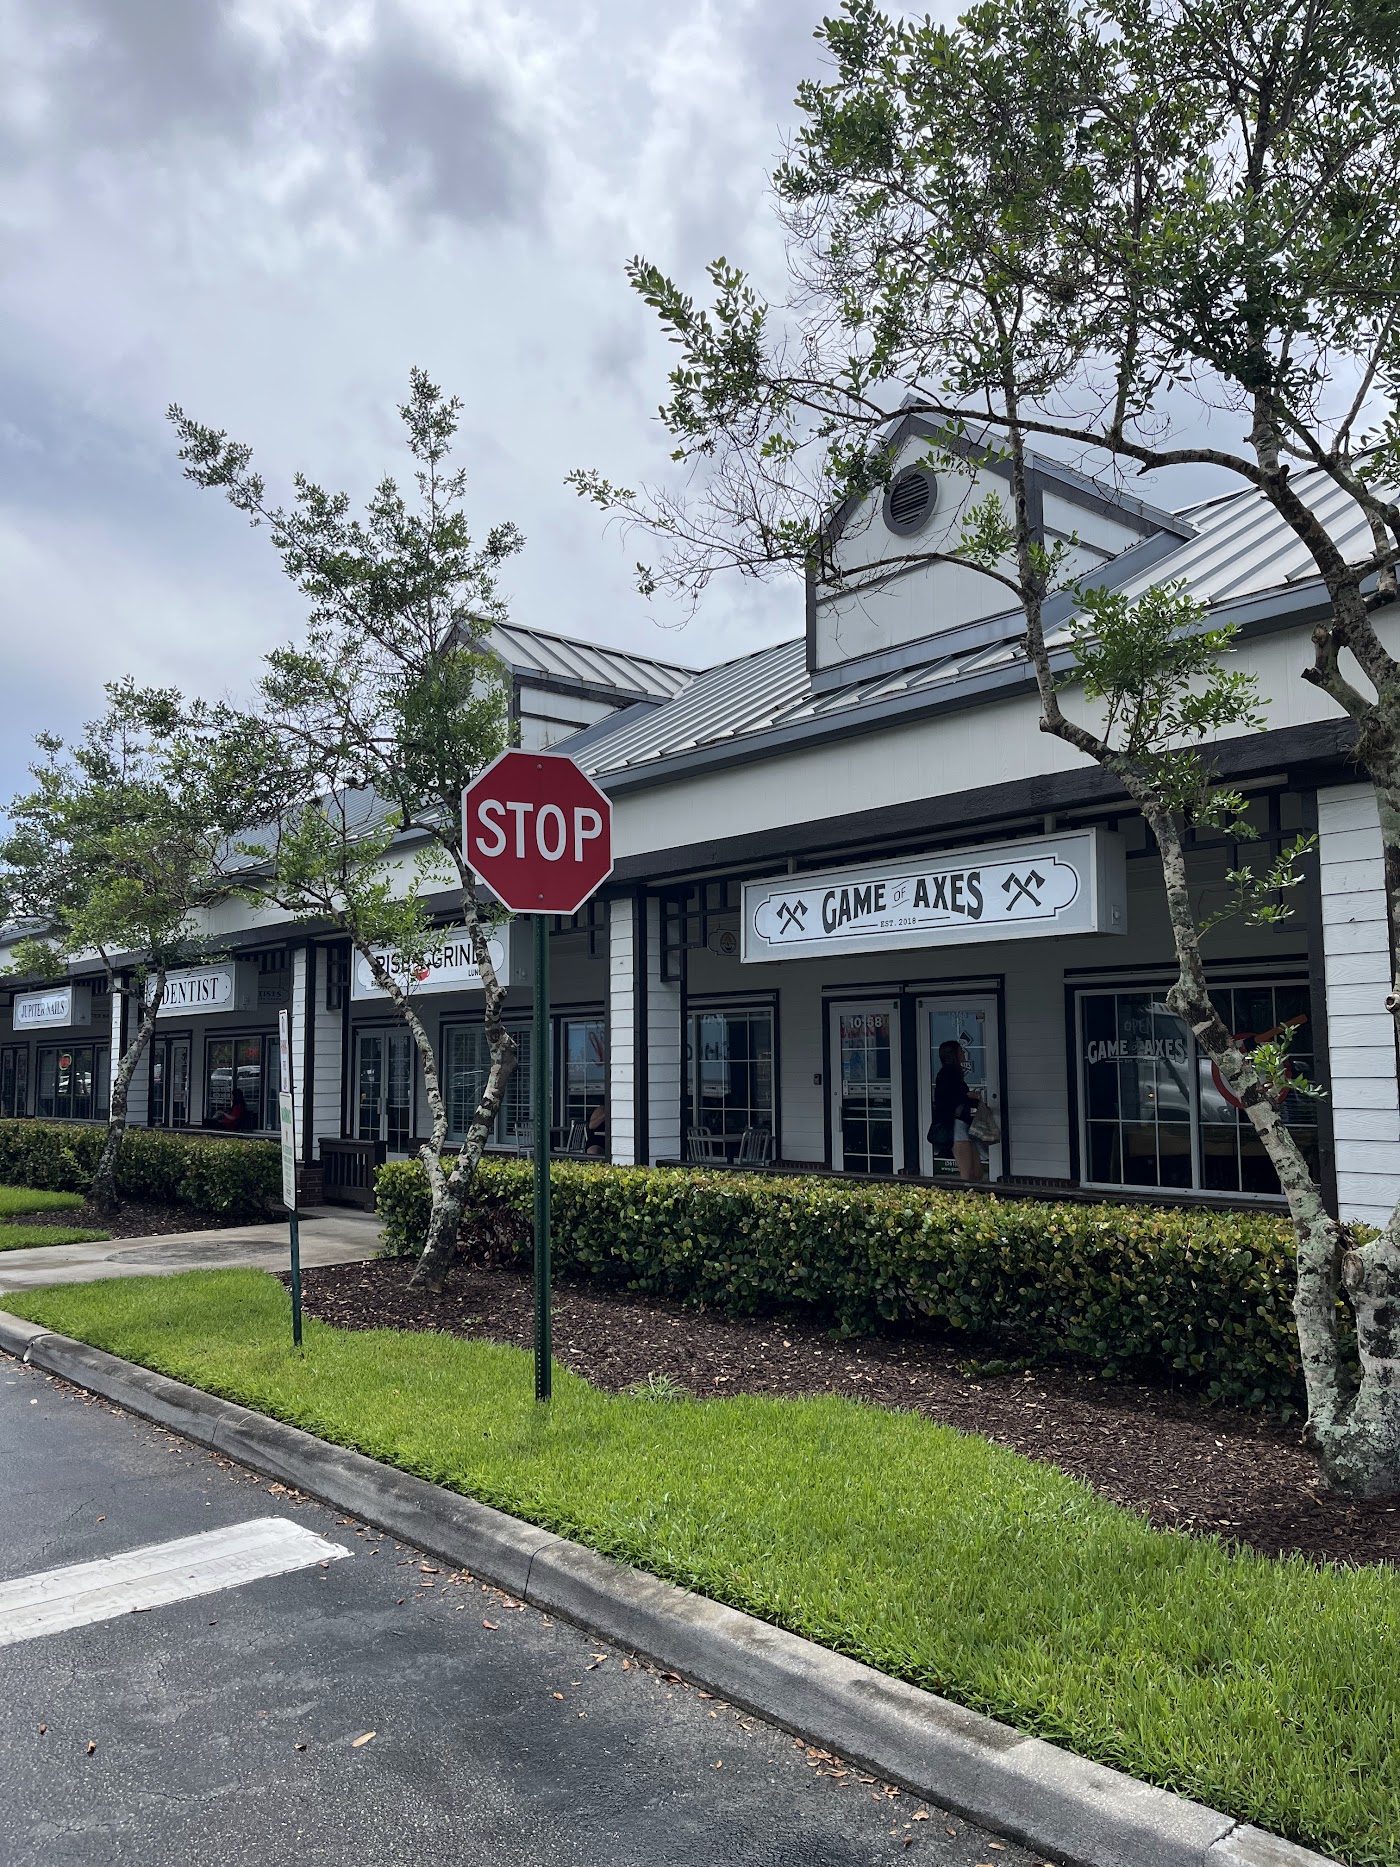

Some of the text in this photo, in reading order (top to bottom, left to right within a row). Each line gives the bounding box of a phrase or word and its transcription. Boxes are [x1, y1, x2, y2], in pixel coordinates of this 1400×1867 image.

[475, 799, 603, 862] STOP
[822, 871, 984, 934] GAME OF AXES
[898, 917, 917, 926] 2018
[161, 977, 219, 1005] DENTIST
[21, 1000, 65, 1018] JUPITER NAILS
[1087, 1039, 1129, 1065] GAME
[1143, 1038, 1186, 1064] AXES
